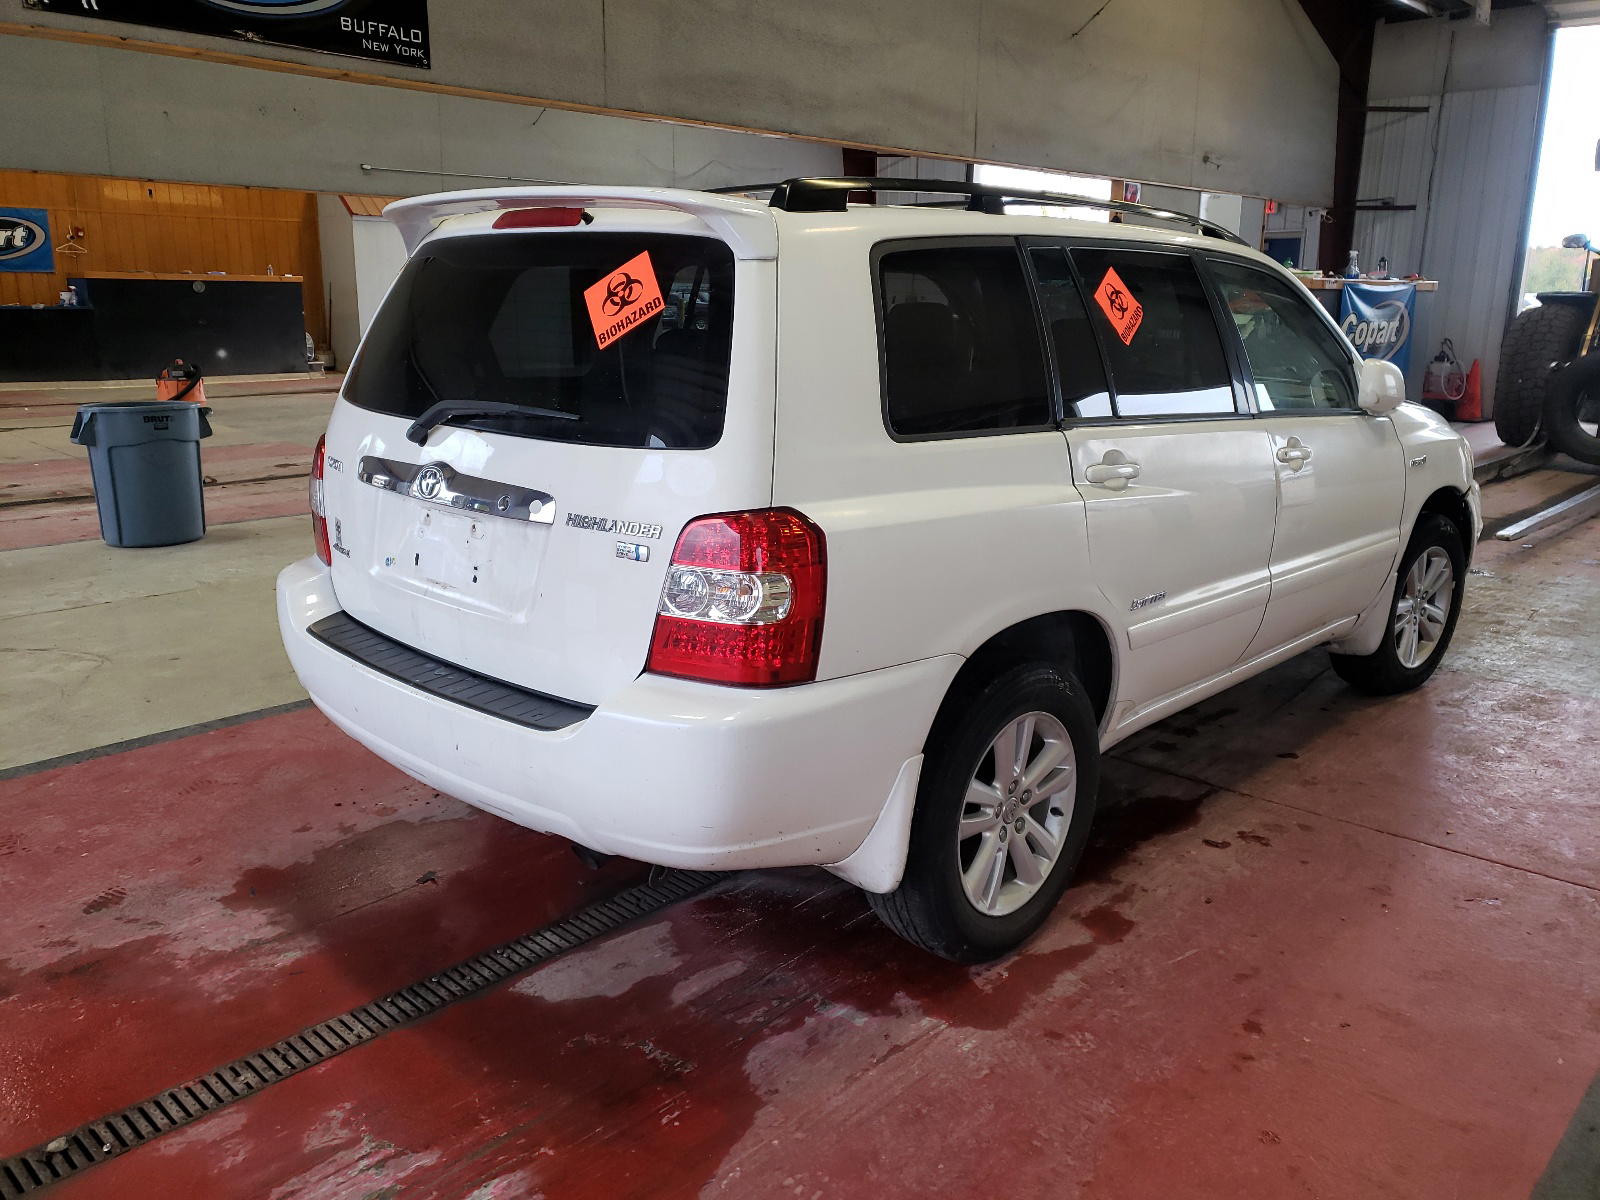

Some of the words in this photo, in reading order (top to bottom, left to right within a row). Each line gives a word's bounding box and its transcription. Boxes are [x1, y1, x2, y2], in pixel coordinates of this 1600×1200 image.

[340, 16, 422, 43] BUFFALO
[362, 38, 390, 53] NEW
[393, 43, 425, 58] YORK
[598, 296, 662, 346] BIOHAZARD
[1120, 305, 1143, 343] BIOHAZARD
[1340, 312, 1400, 353] Copart
[565, 512, 663, 540] HIGHLANDER
